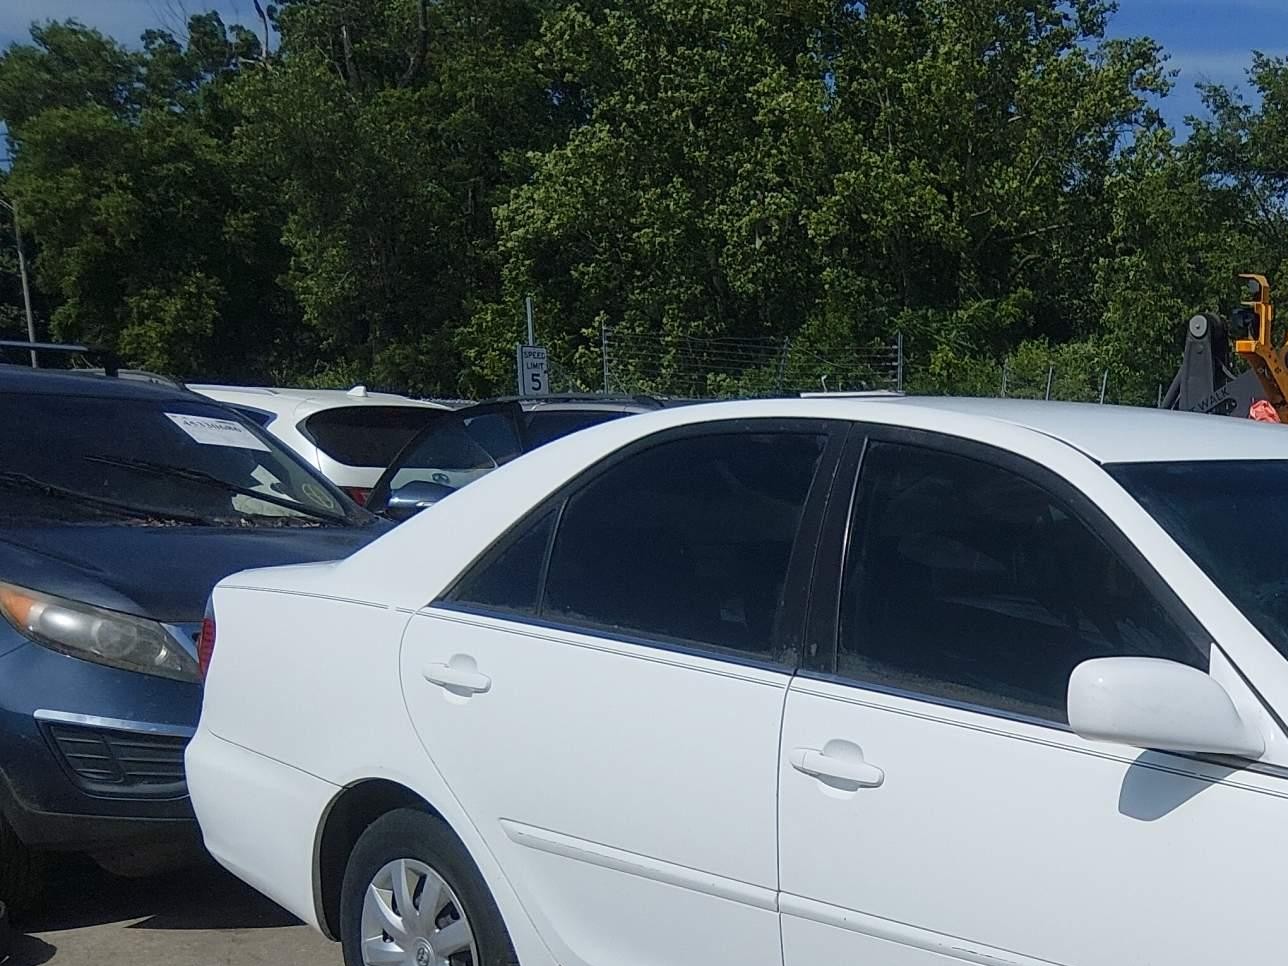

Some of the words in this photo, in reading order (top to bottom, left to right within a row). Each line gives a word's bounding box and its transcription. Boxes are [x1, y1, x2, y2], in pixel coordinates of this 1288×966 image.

[523, 351, 546, 360] SPEED
[527, 362, 544, 370] LIMIT
[531, 373, 542, 391] 5
